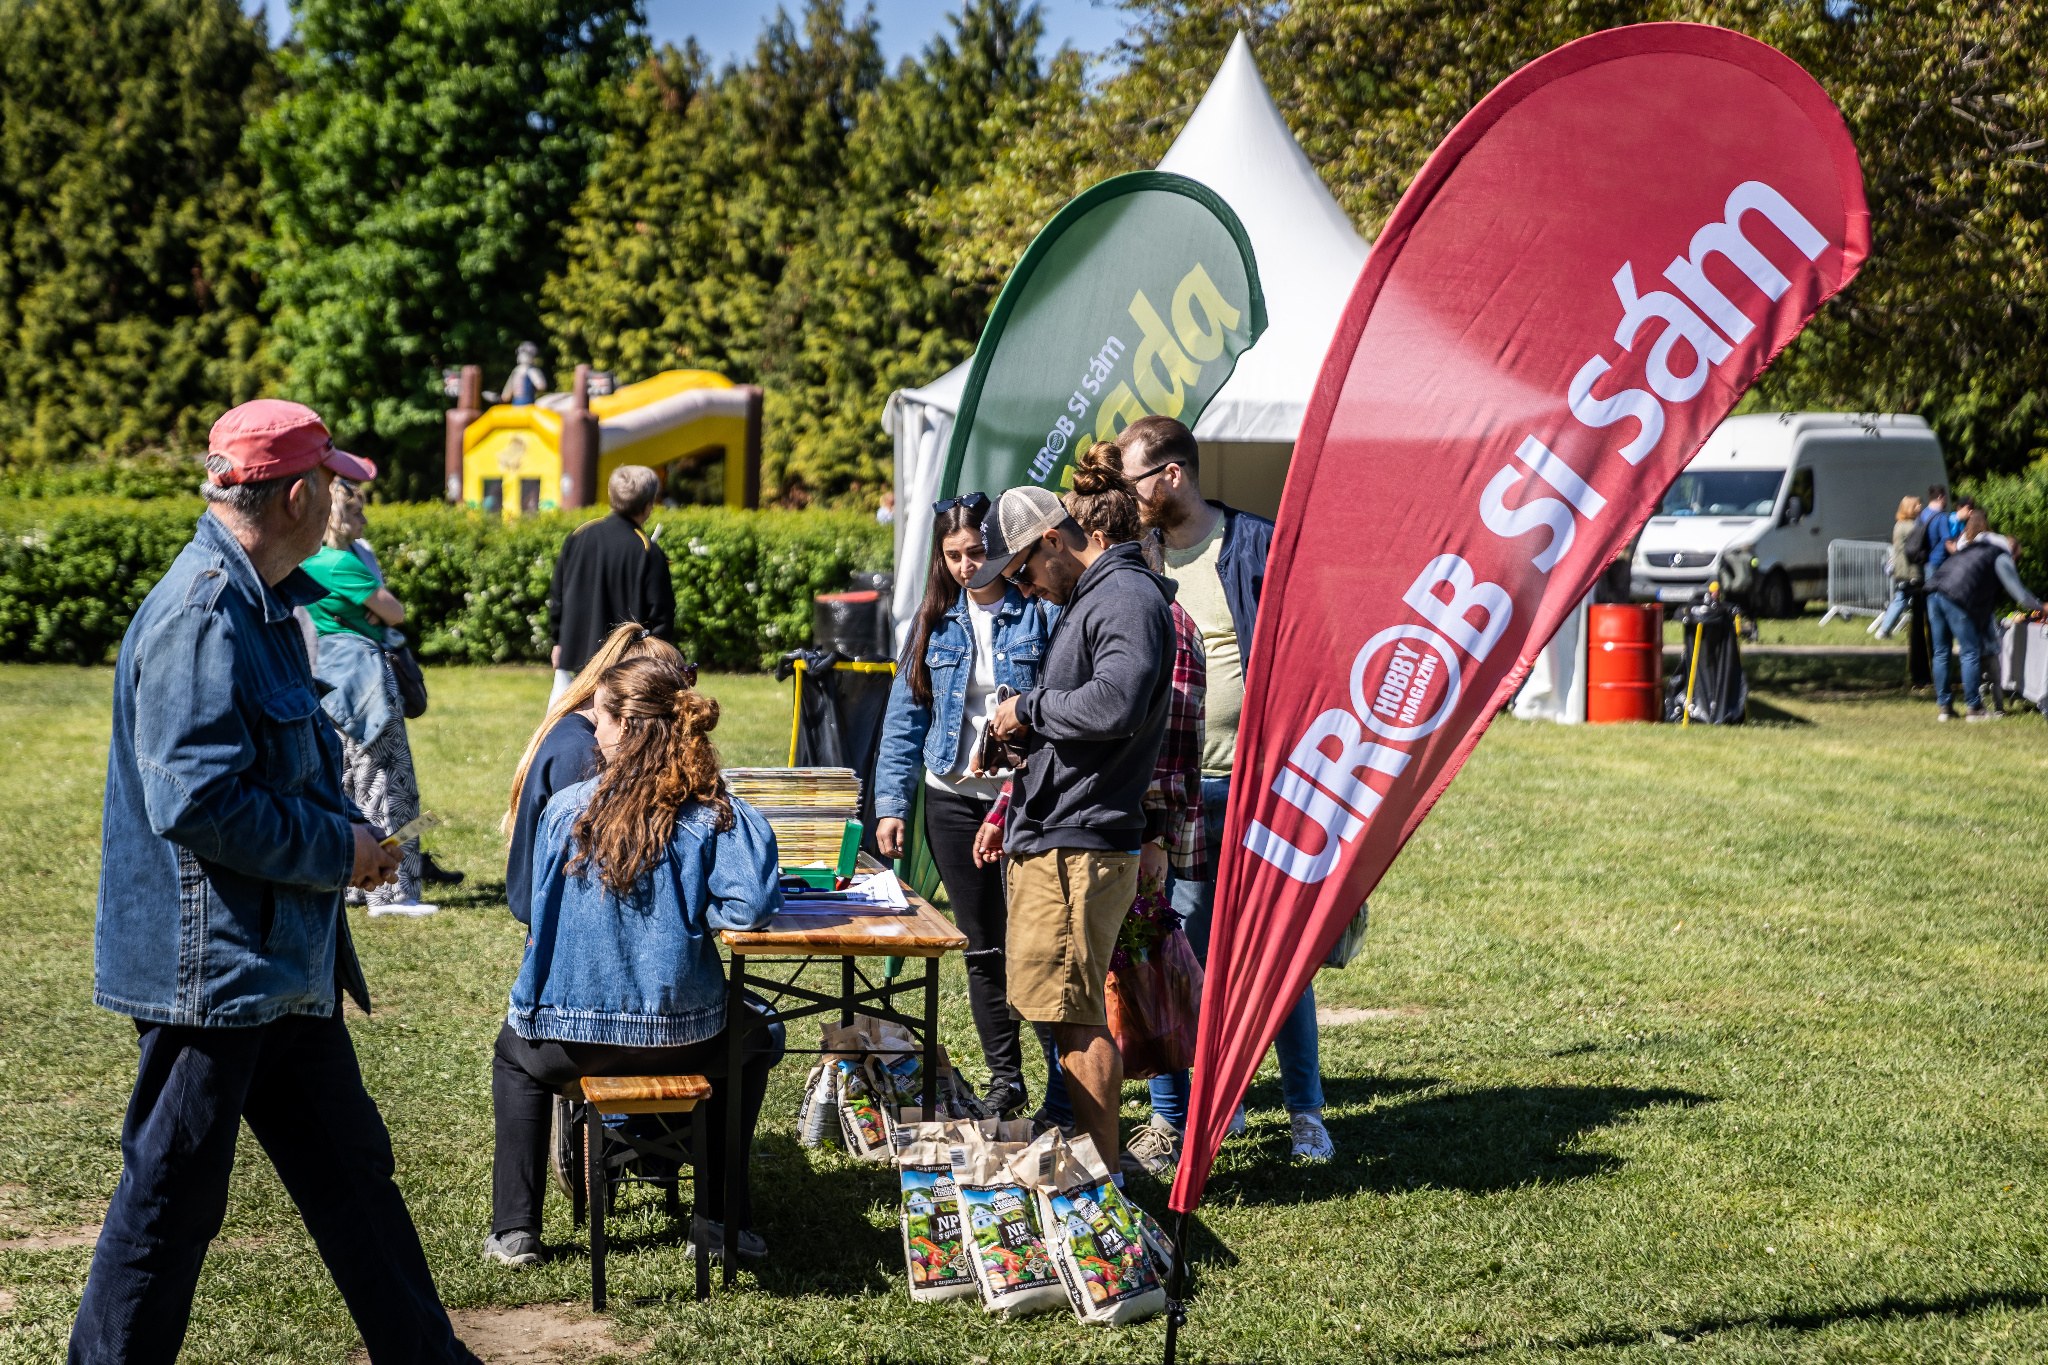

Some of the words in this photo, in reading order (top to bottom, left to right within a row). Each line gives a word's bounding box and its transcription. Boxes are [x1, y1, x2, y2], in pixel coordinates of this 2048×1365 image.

[1027, 414, 1076, 483] UROB
[1242, 553, 1513, 884] UROB
[1479, 434, 1607, 573] SI
[1373, 641, 1420, 718] HOBBY
[1399, 653, 1439, 724] MAGAZÍN
[937, 1214, 961, 1232] NP
[1005, 1222, 1026, 1239] NP
